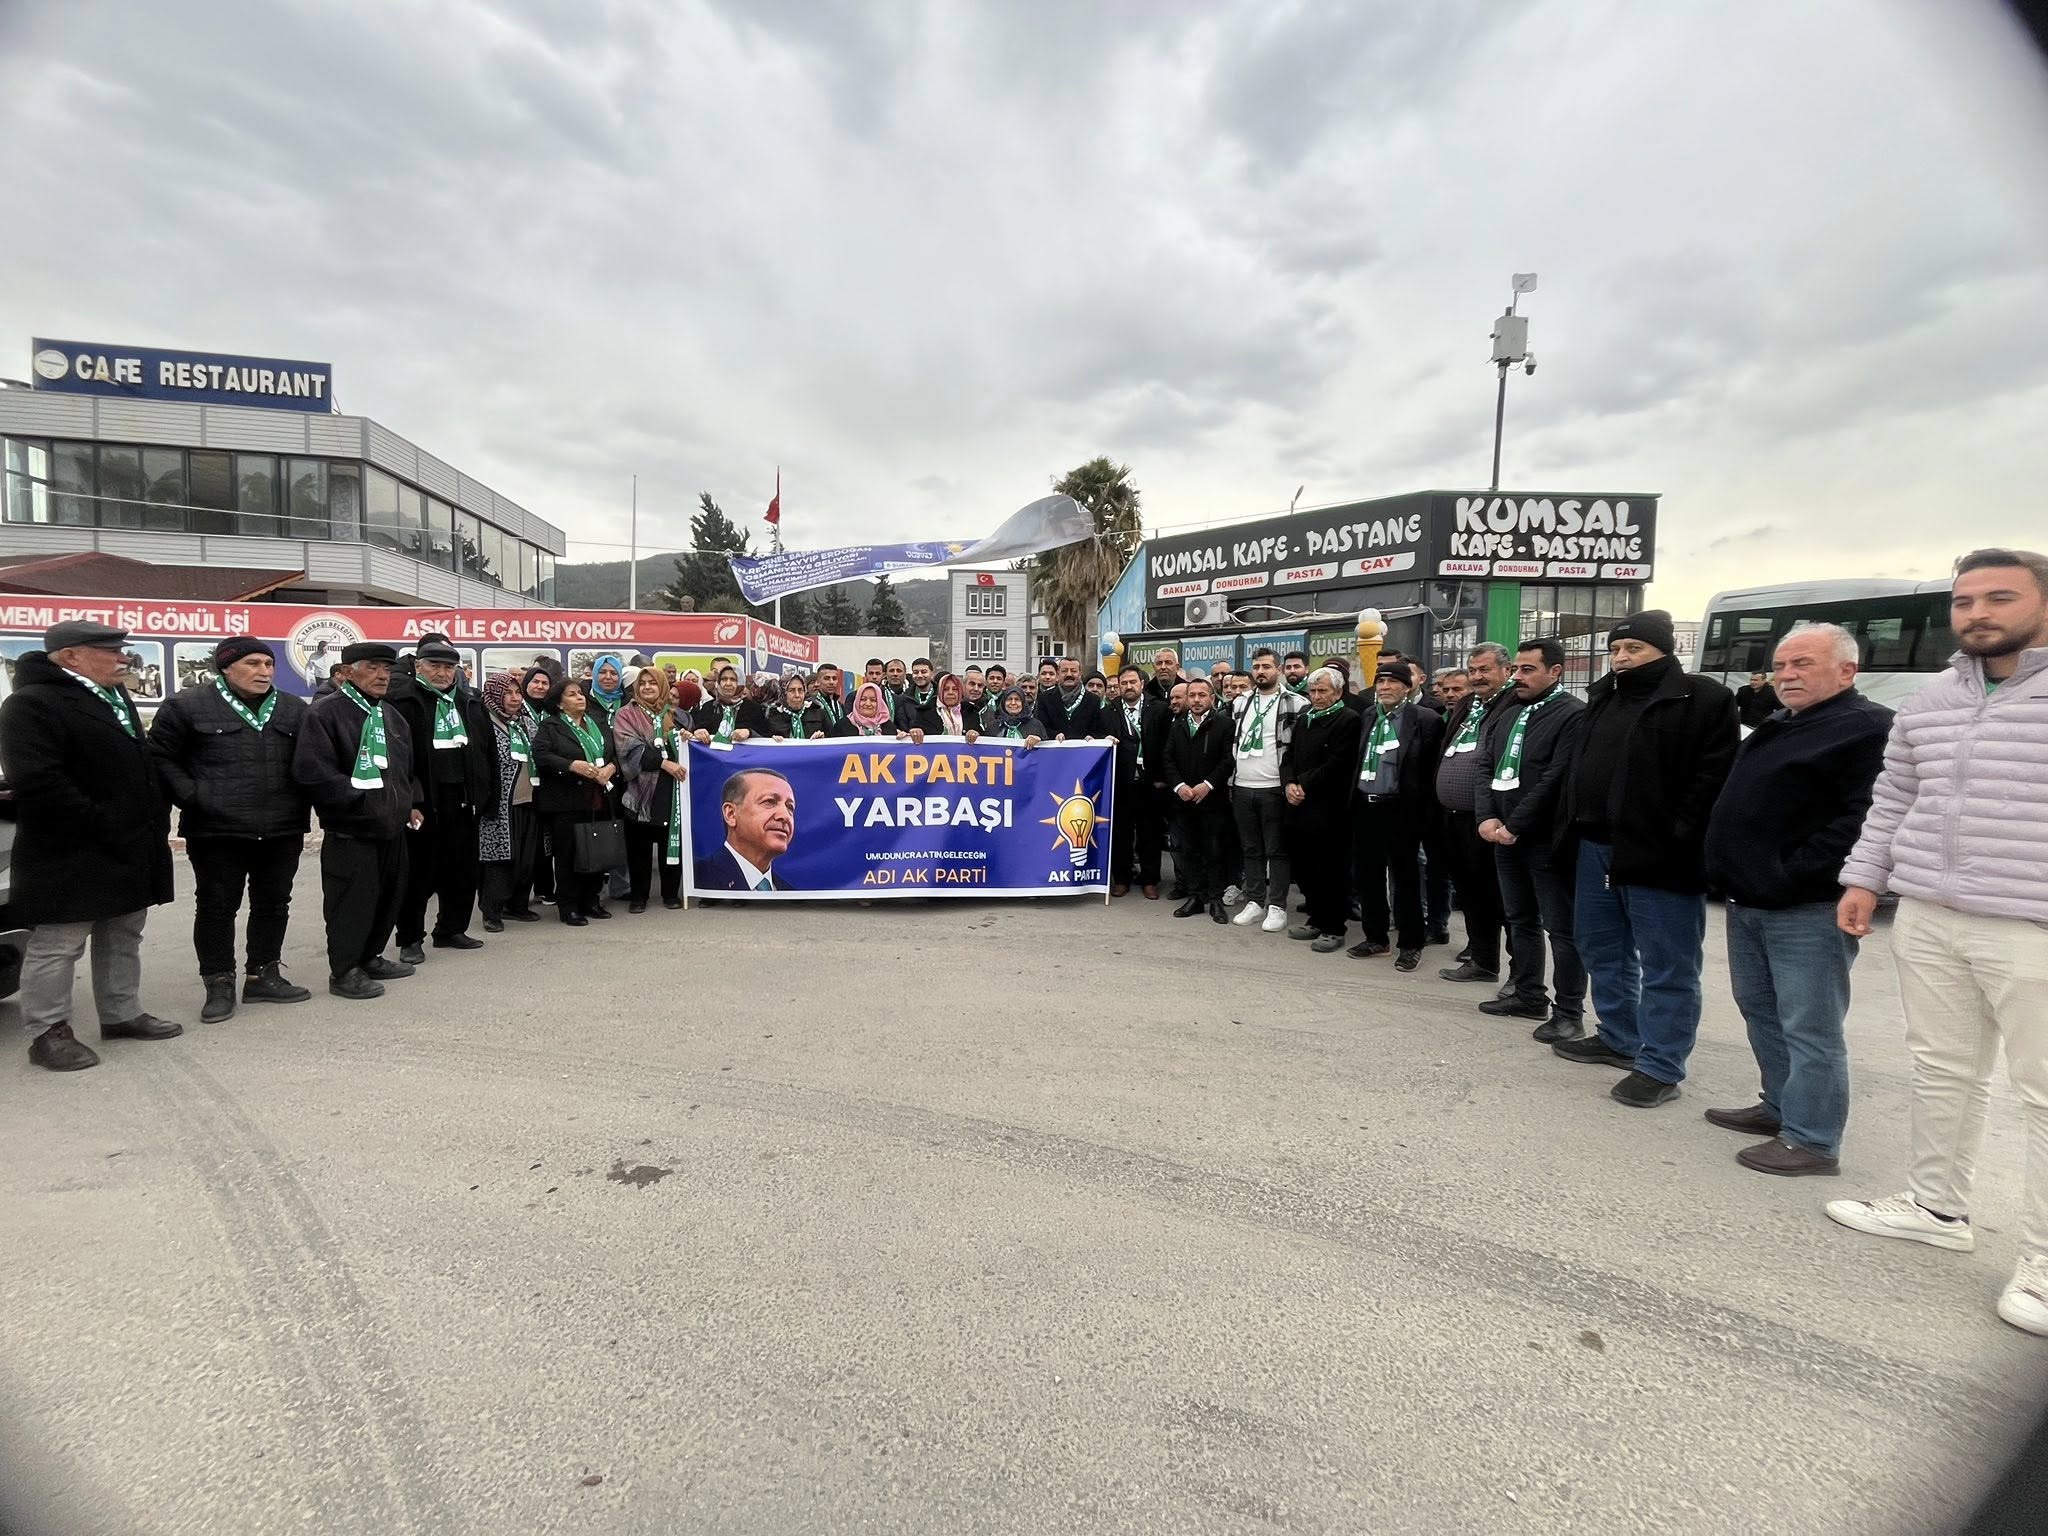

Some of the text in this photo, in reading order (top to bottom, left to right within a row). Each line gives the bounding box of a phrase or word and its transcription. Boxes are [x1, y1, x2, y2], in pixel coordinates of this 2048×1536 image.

[75, 354, 326, 399] CAFE RESTAURANT
[1456, 497, 1640, 535] KUMSAL
[1151, 546, 1228, 578] KUMSAL
[1233, 535, 1288, 567] KAFE
[1306, 513, 1422, 556] PASTANE
[1451, 532, 1514, 559] KAFE
[1532, 534, 1642, 561] PASTANE
[1163, 556, 1395, 596] BAKLAVA DONDURMA PASTA ÇAY
[1446, 563, 1638, 580] BAKLAVA DONDURMA PASTA ÇAY
[117, 605, 143, 634] İŞİ
[146, 607, 221, 632] GÖNÜL
[224, 608, 250, 637] İŞİ
[454, 614, 486, 638] İLE
[490, 619, 635, 641] ÇALIŞIYORUZ
[1184, 645, 1234, 661] DONDURMA
[838, 749, 1014, 786] AK PARTİ
[834, 796, 1013, 833] YARBAŞI
[863, 866, 986, 884] ADI AK PARTİ
[1048, 868, 1101, 882] AK PARTİ
